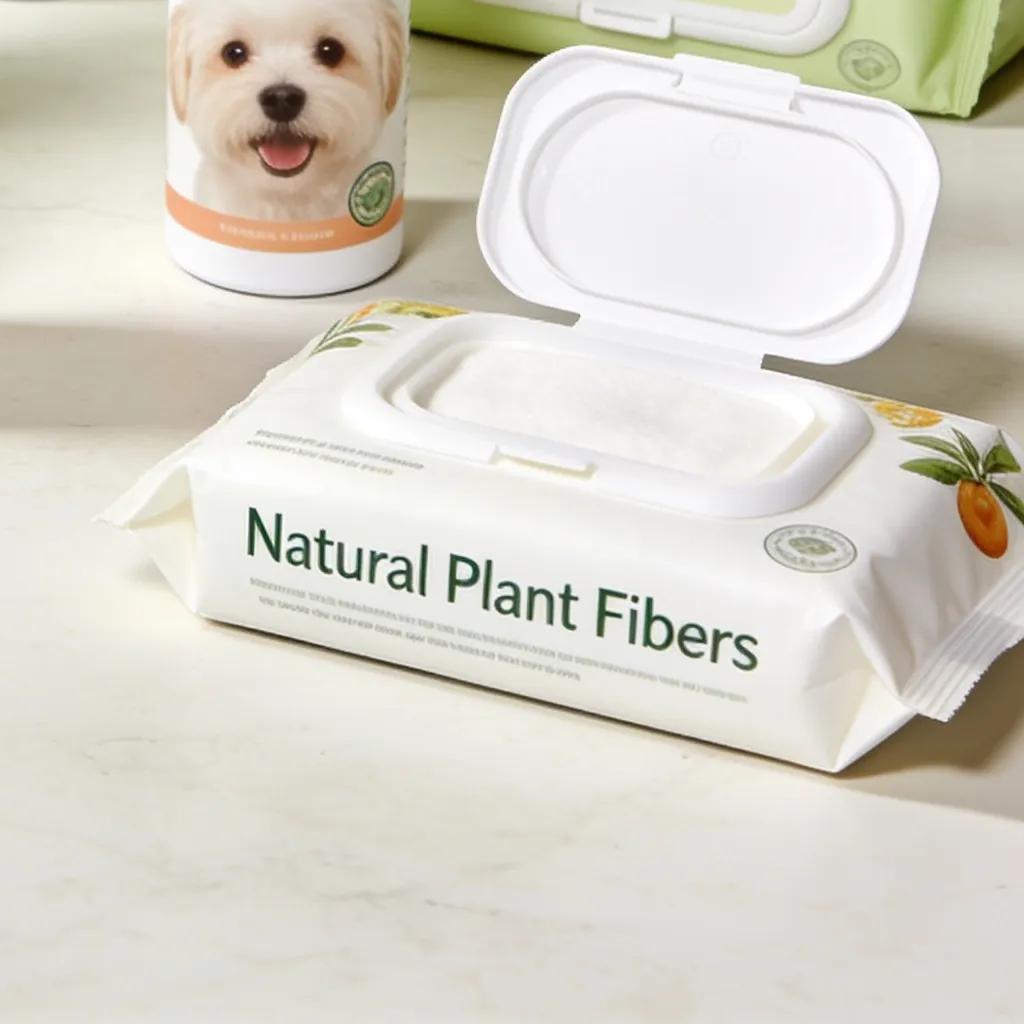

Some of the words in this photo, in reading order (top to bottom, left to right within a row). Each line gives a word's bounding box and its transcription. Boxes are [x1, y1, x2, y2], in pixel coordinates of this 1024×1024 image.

[246, 506, 429, 596] Natural
[447, 552, 578, 631] Plant
[596, 587, 760, 672] Fibers
